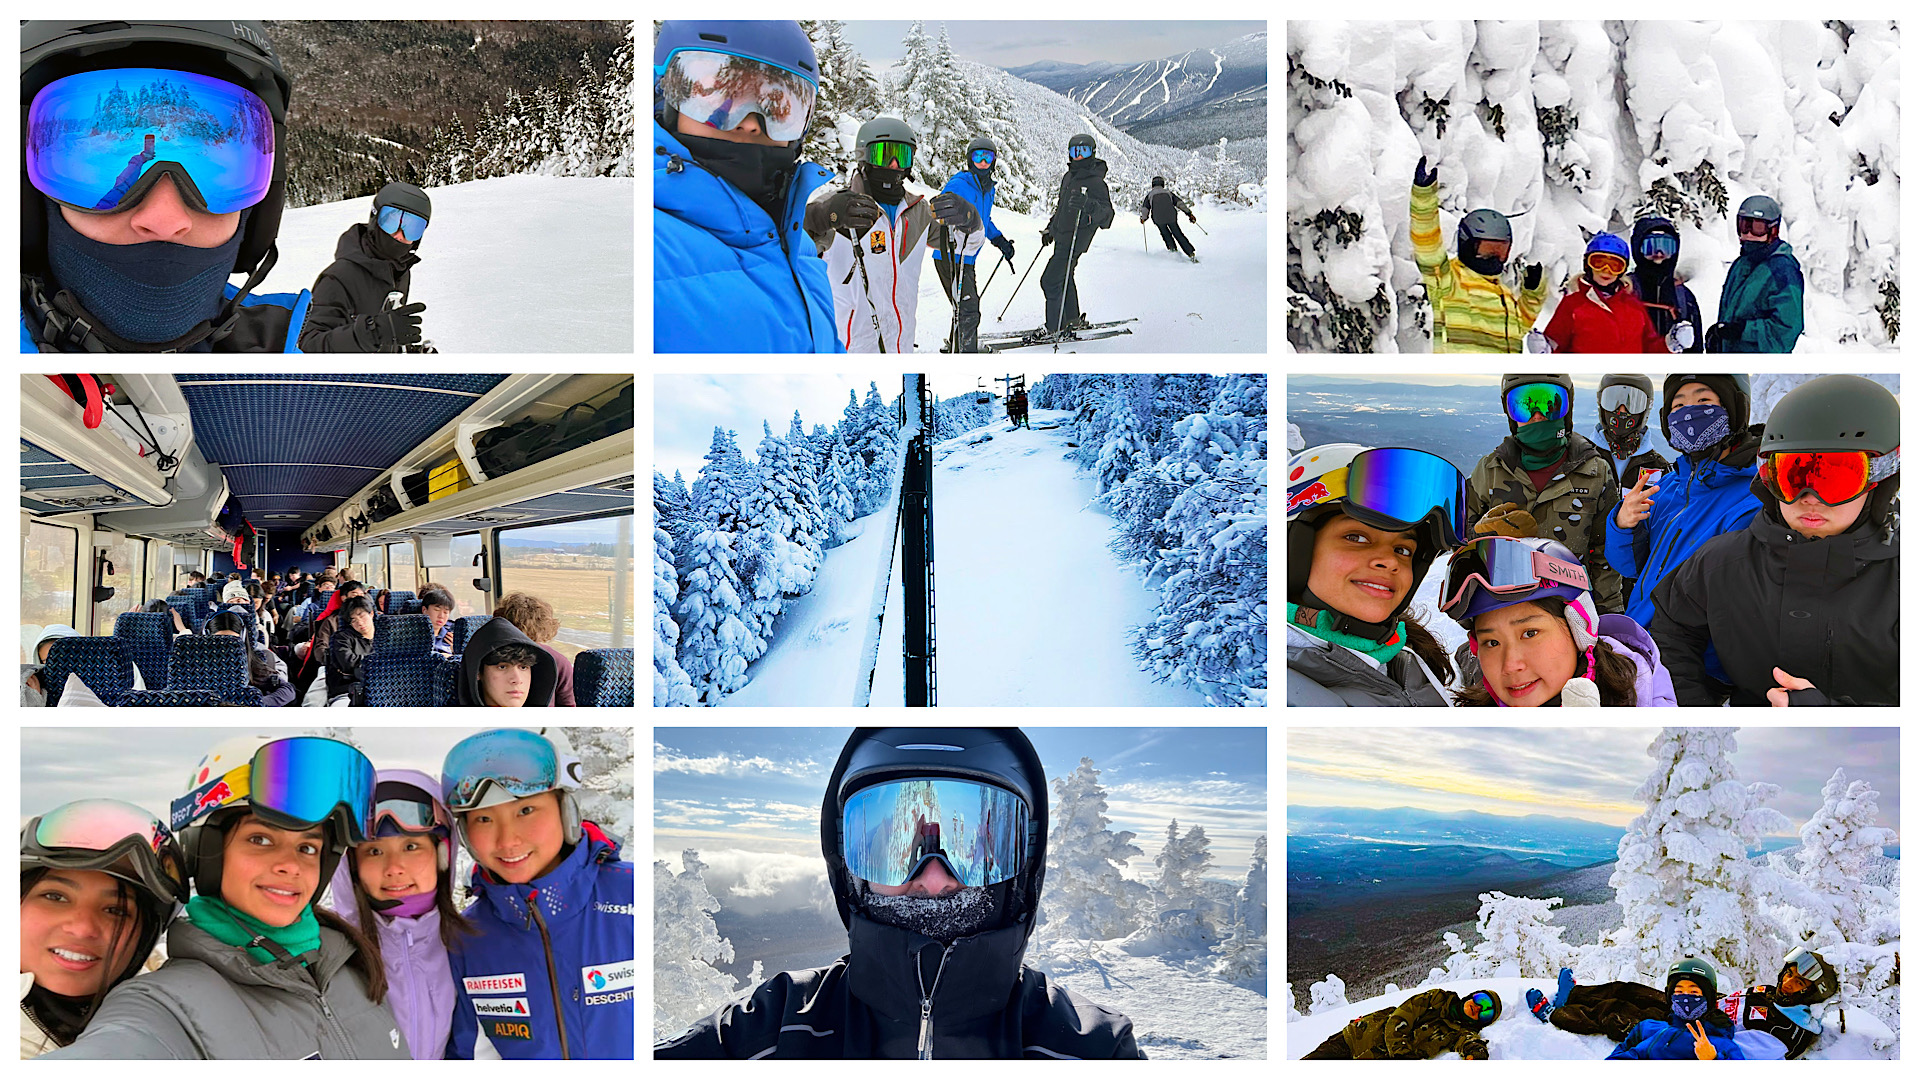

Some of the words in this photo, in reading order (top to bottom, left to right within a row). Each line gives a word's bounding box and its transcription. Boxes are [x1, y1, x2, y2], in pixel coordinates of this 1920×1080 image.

[1548, 561, 1586, 582] SMITH
[466, 977, 523, 991] RAIFFEISEN
[475, 1003, 513, 1013] helvetia
[494, 1022, 531, 1039] ALPIQ
